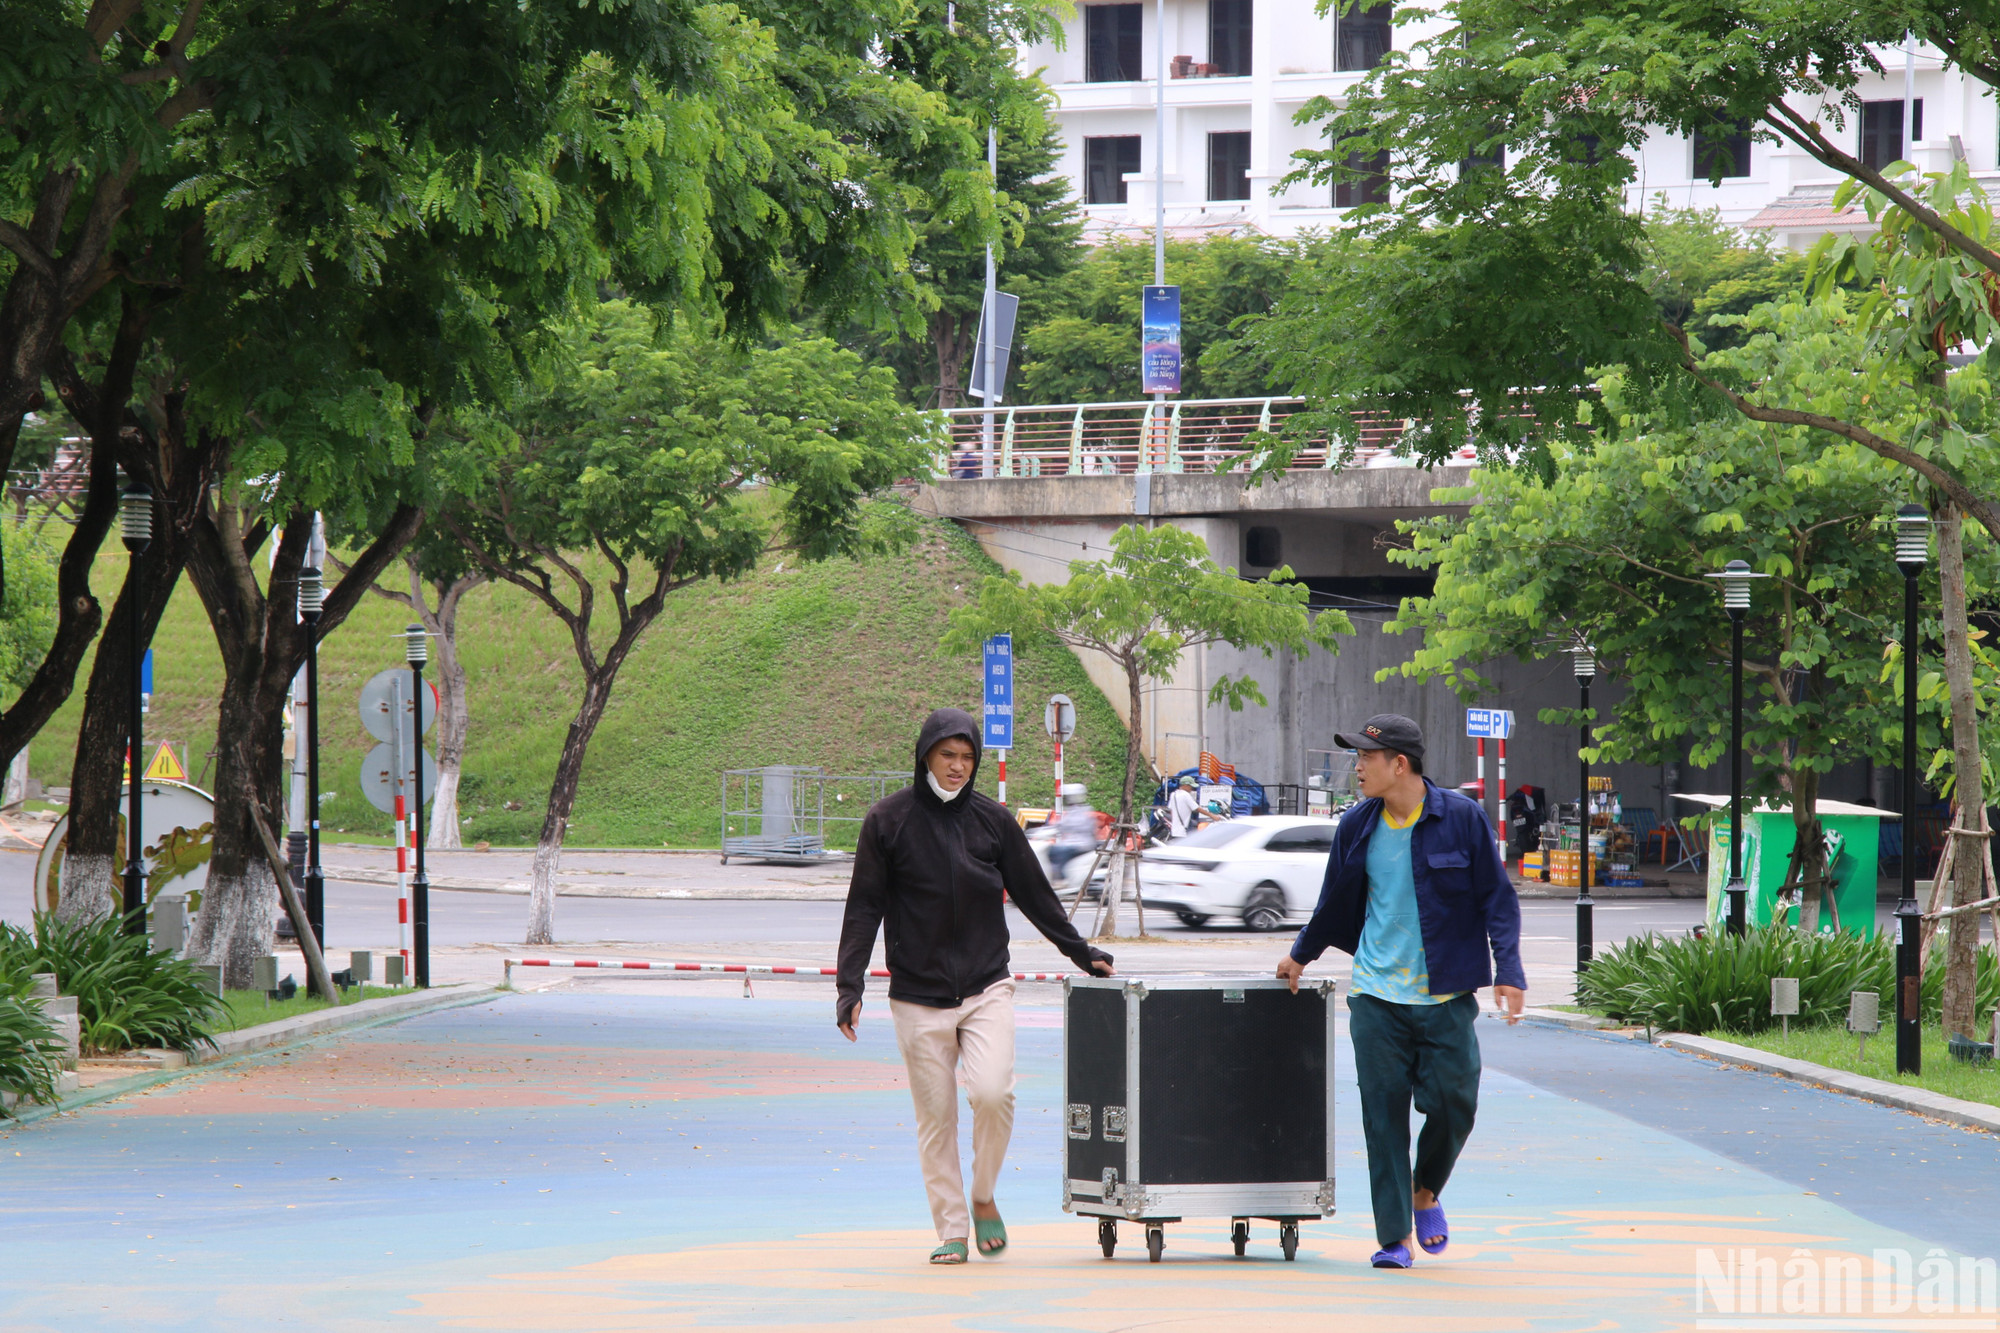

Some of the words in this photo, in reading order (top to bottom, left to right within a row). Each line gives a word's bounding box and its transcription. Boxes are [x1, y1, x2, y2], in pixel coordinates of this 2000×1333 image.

[992, 664, 1005, 675] AHEAD
[1469, 723, 1483, 732] Parking
[1493, 713, 1502, 734] P
[991, 724, 1005, 735] WORKS
[1367, 725, 1382, 735] EA7
